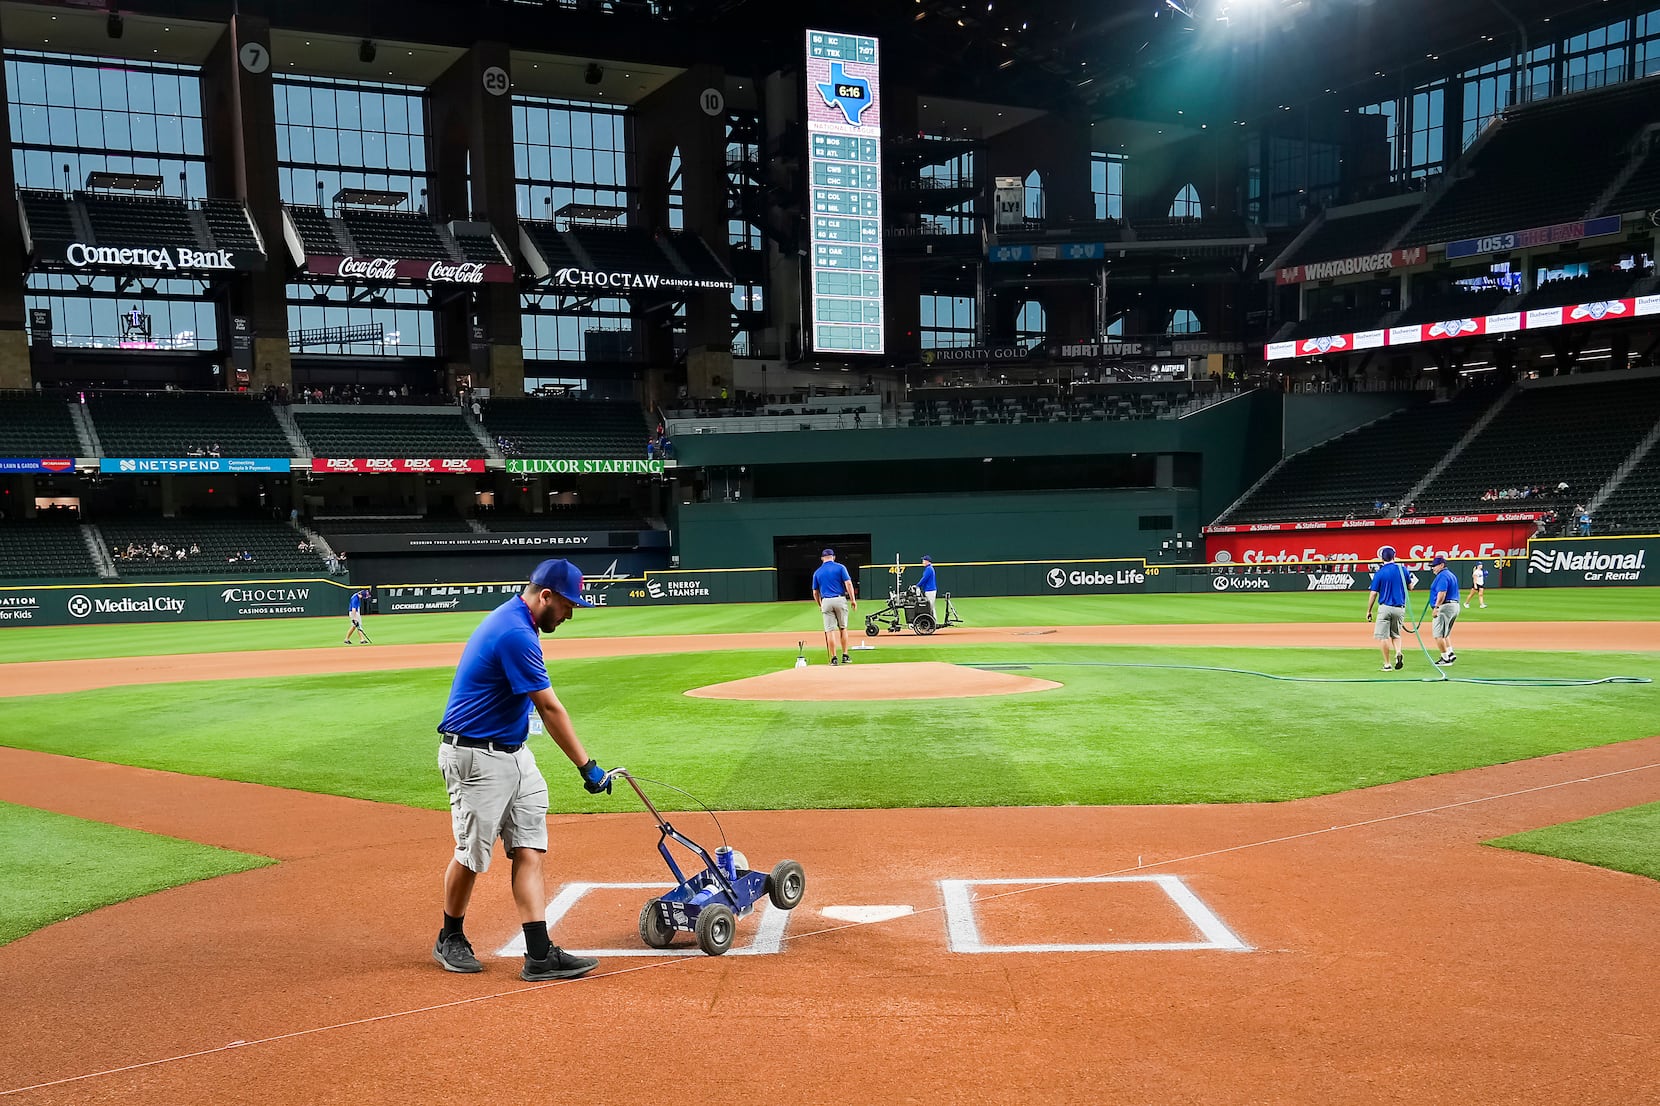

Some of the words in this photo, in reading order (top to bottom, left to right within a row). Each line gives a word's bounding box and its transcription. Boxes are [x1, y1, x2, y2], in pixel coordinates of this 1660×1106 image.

[828, 37, 838, 45] KC
[827, 49, 840, 57] TEX
[859, 46, 873, 55] 7:07
[249, 49, 260, 66] 7
[486, 73, 506, 89] 29
[839, 86, 860, 98] 6:16
[705, 94, 719, 110] 10
[814, 123, 848, 132] NATIONAL
[849, 126, 875, 134] LEAGUE
[826, 138, 840, 146] BOS
[826, 148, 838, 156] ATL
[827, 177, 841, 185] CHC
[828, 193, 841, 201] COL
[1001, 201, 1020, 213] LY!
[1477, 235, 1515, 252] 105.3
[1517, 229, 1548, 246] THE
[1550, 222, 1584, 242] FAN
[176, 248, 235, 269] Bank
[338, 256, 399, 280] Coca-Cola
[426, 260, 487, 284] Coca-Cola
[1304, 253, 1393, 280] WHATABURGER
[566, 268, 660, 289] CHOCTAW
[660, 278, 693, 287] CASINOS
[700, 281, 733, 289] RESORTS
[1062, 344, 1099, 357] HART
[1103, 343, 1142, 355] HVAC
[1174, 342, 1244, 353] PLUCKERS
[936, 349, 991, 360] PRIORITY
[994, 348, 1028, 358] GOLD
[139, 460, 219, 470] NETSPEND
[327, 458, 355, 467] DEX
[365, 458, 394, 467] DEX
[403, 459, 431, 468] DEX
[441, 458, 469, 468] DEX
[522, 459, 579, 473] LUXOR
[583, 459, 660, 473] STAFFING
[501, 537, 541, 545] AHEAD
[1494, 560, 1511, 568] 374
[1069, 570, 1114, 585] Globe
[1116, 569, 1144, 584] Life
[1145, 568, 1160, 576] 410
[1584, 572, 1603, 581] Car
[1605, 571, 1640, 580] Rental
[1230, 577, 1270, 589] Kubota
[1319, 573, 1347, 584] ARROW
[667, 581, 701, 590] ENERGY
[230, 588, 309, 602] CHOCTAW
[629, 590, 645, 598] 410
[668, 588, 710, 598] TRANSFER
[94, 597, 153, 613] Medical
[155, 596, 186, 614] City
[0, 611, 13, 620] for
[13, 610, 33, 619] Kids
